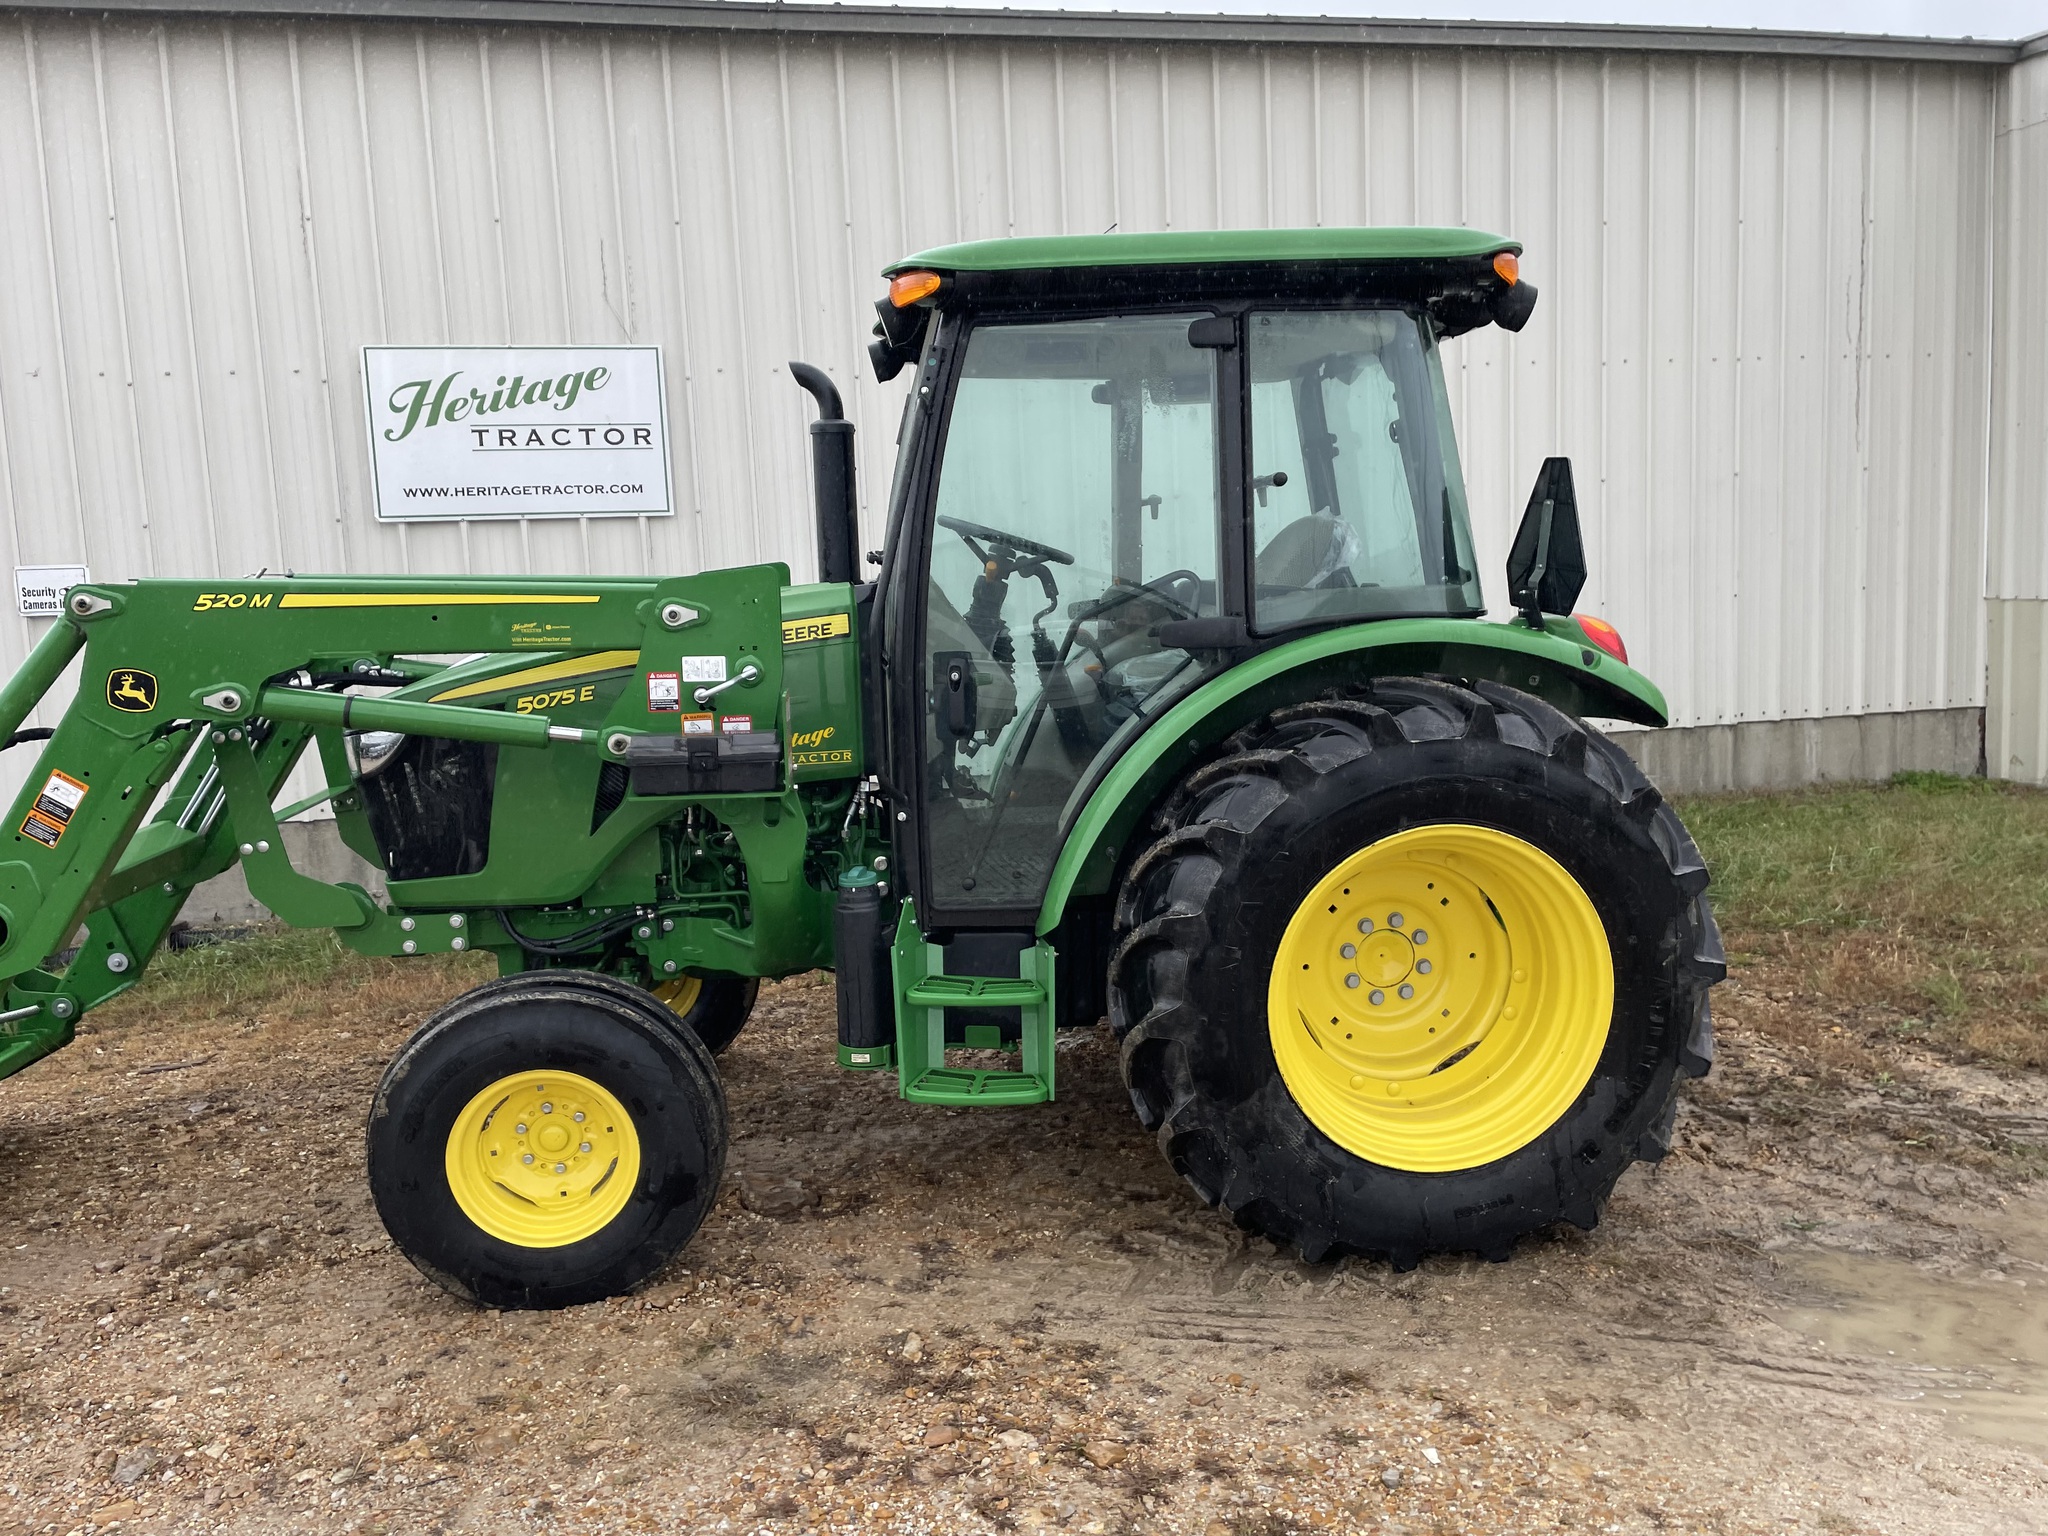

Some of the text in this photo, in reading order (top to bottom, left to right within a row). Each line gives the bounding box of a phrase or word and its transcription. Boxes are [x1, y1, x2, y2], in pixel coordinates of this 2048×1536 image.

[384, 366, 612, 442] Heritage
[471, 427, 652, 447] TRACTOR
[403, 484, 644, 498] WWW.HERITAGETRACTOR.COM
[21, 586, 56, 598] Security
[23, 599, 57, 610] Cameras
[192, 593, 274, 611] 520 M
[781, 622, 833, 642] EERE
[516, 685, 595, 715] 5075 E
[791, 726, 835, 748] tage
[791, 752, 852, 764] ACTOR
